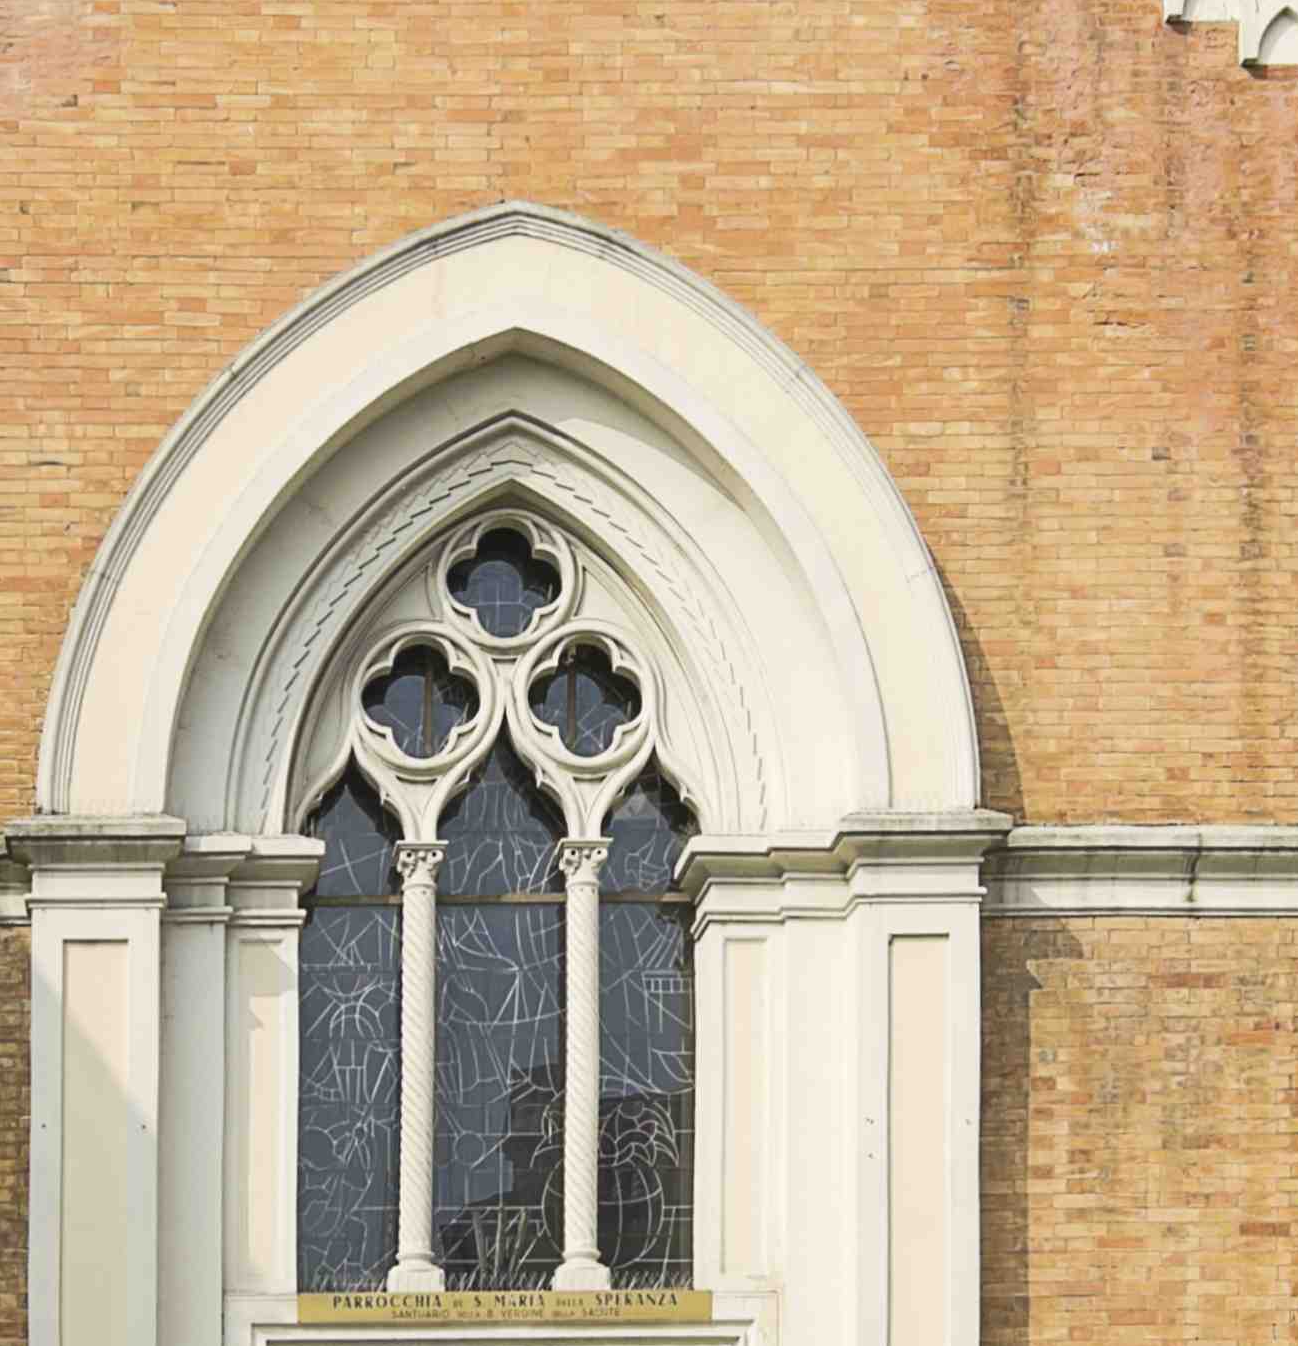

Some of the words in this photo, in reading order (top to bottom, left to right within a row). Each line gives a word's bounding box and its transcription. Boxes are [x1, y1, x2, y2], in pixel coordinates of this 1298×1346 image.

[332, 1295, 442, 1309] PARROCCHIA
[494, 1294, 545, 1308] MARIA
[595, 1293, 678, 1307] SPERANZA
[391, 1310, 448, 1320] SANTUARIO
[501, 1309, 544, 1319] VERGINE
